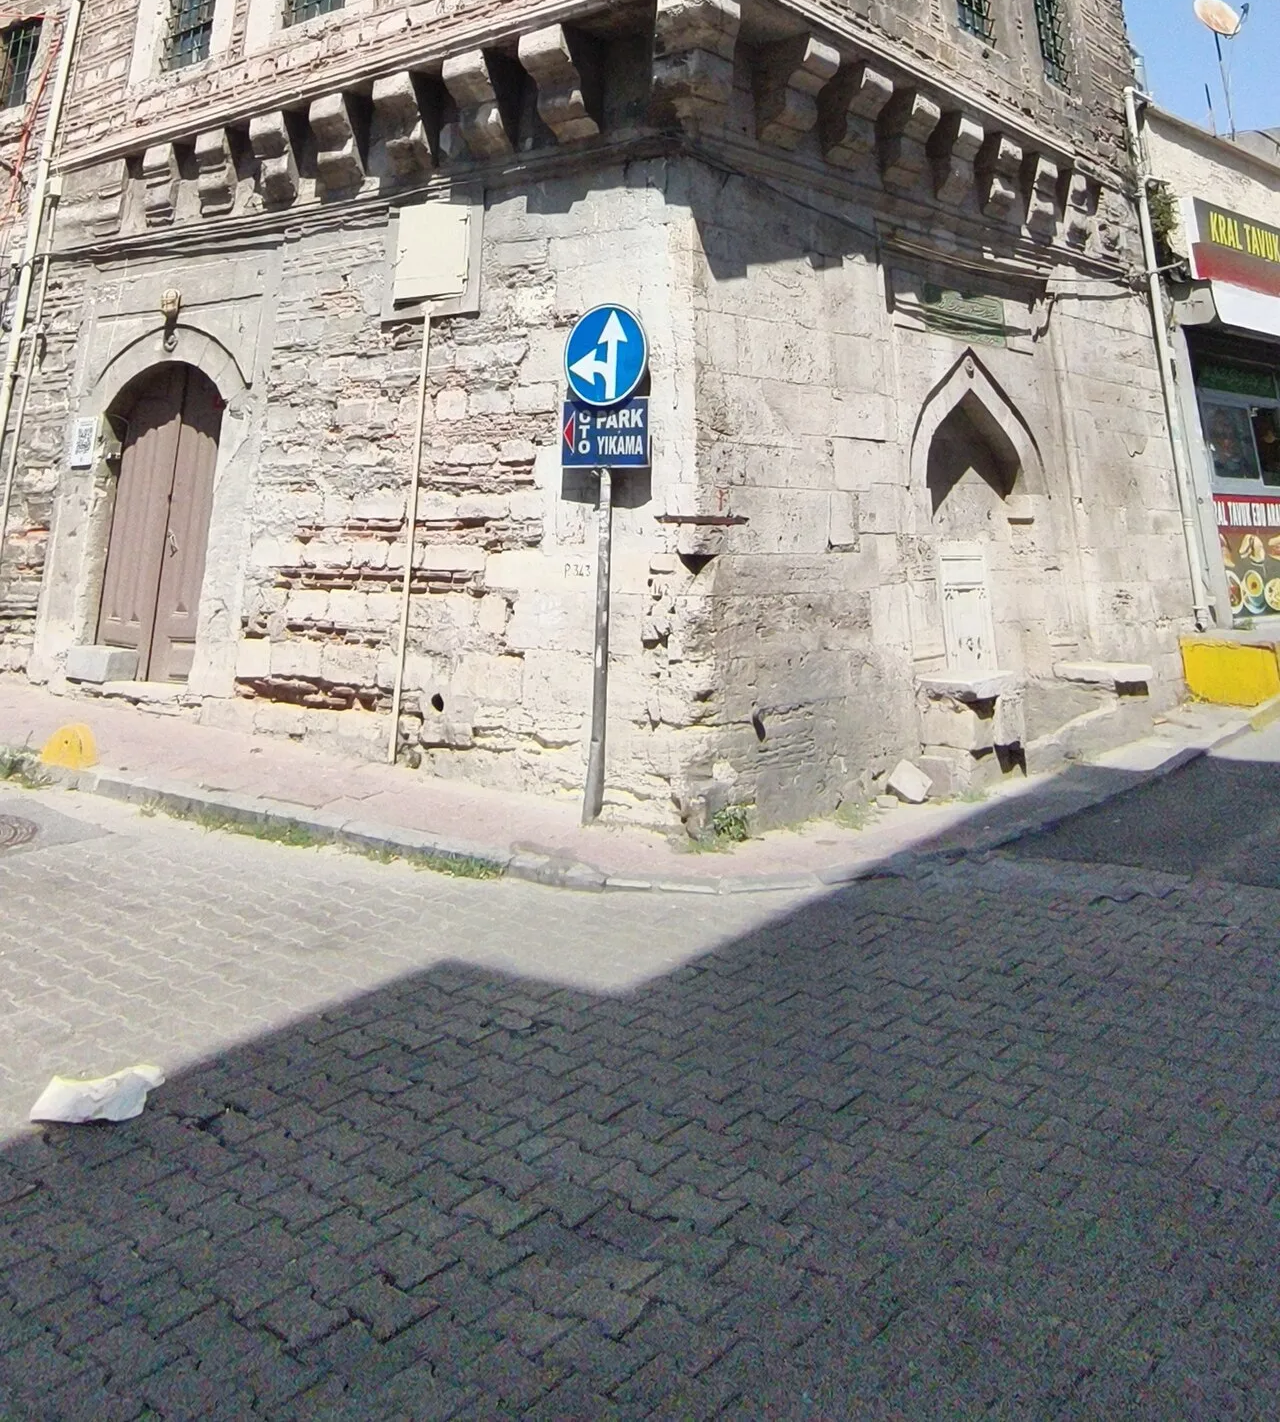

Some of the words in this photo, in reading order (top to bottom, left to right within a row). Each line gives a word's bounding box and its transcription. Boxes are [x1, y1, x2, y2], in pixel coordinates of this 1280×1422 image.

[1209, 211, 1243, 250] KRAL
[1243, 223, 1280, 263] TAVUK
[578, 410, 591, 454] OTO
[596, 409, 644, 429] PARK
[597, 435, 643, 455] YIKAMA
